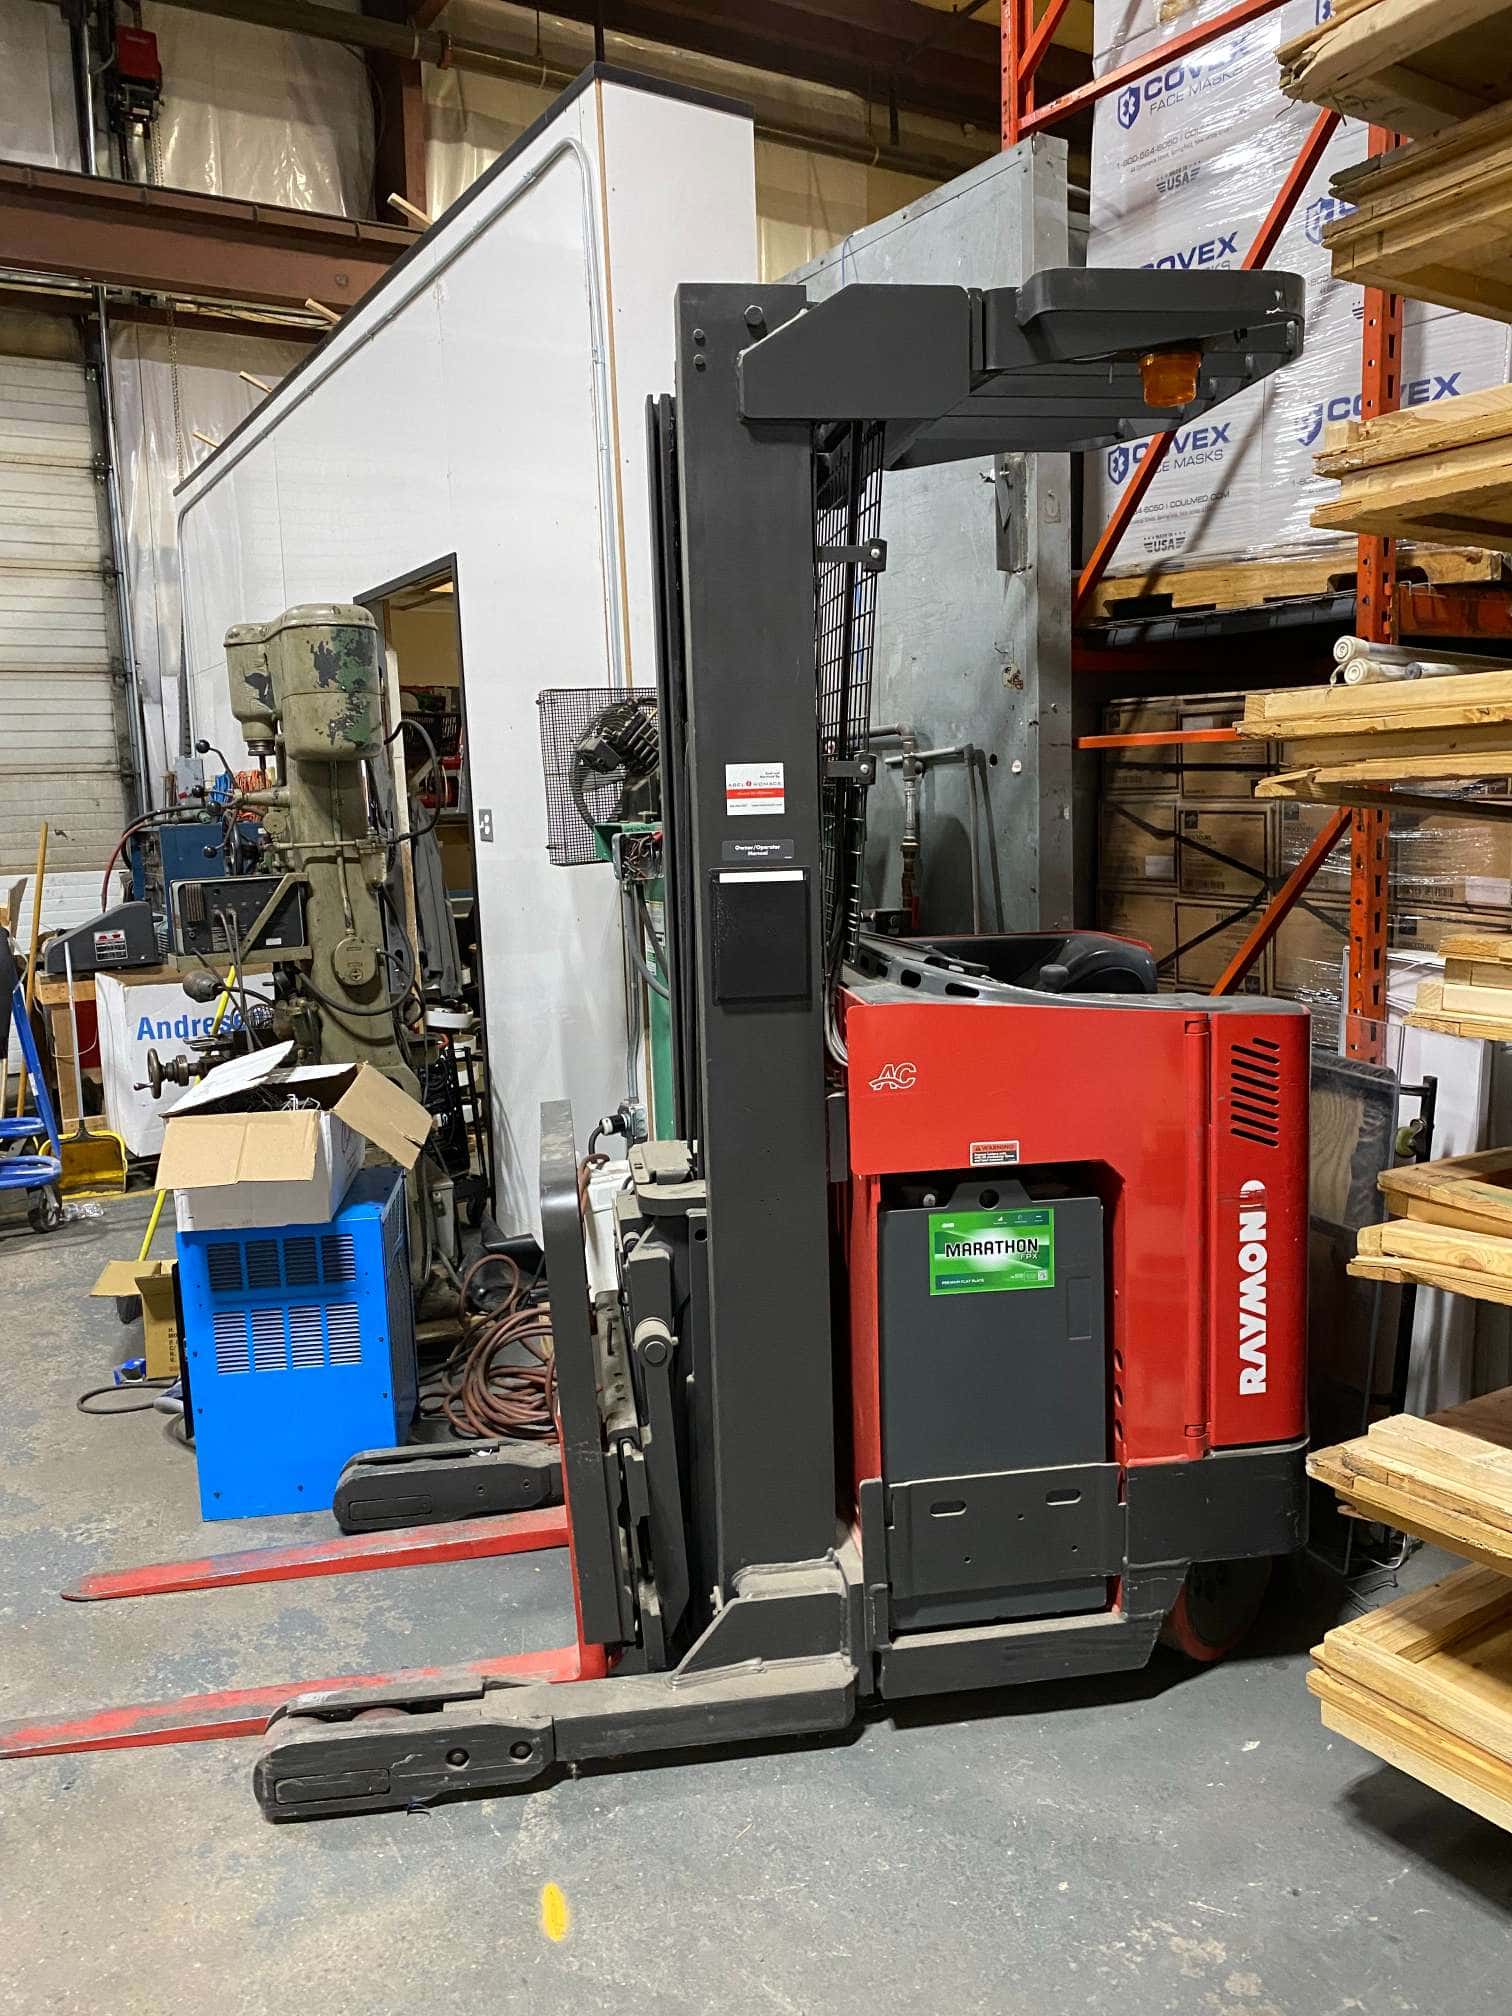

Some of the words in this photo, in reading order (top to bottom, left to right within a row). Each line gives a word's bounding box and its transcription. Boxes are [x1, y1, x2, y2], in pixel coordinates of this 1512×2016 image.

[1149, 93, 1185, 115] FACE
[1167, 173, 1190, 191] USA
[1141, 230, 1239, 269] OVEX
[1132, 422, 1232, 463] CVEX
[1173, 449, 1223, 470] MASKS
[1154, 540, 1175, 553] USA
[869, 1062, 917, 1091] AC
[945, 1238, 1038, 1258] MARATHON
[1238, 1180, 1267, 1395] RAYMOND
